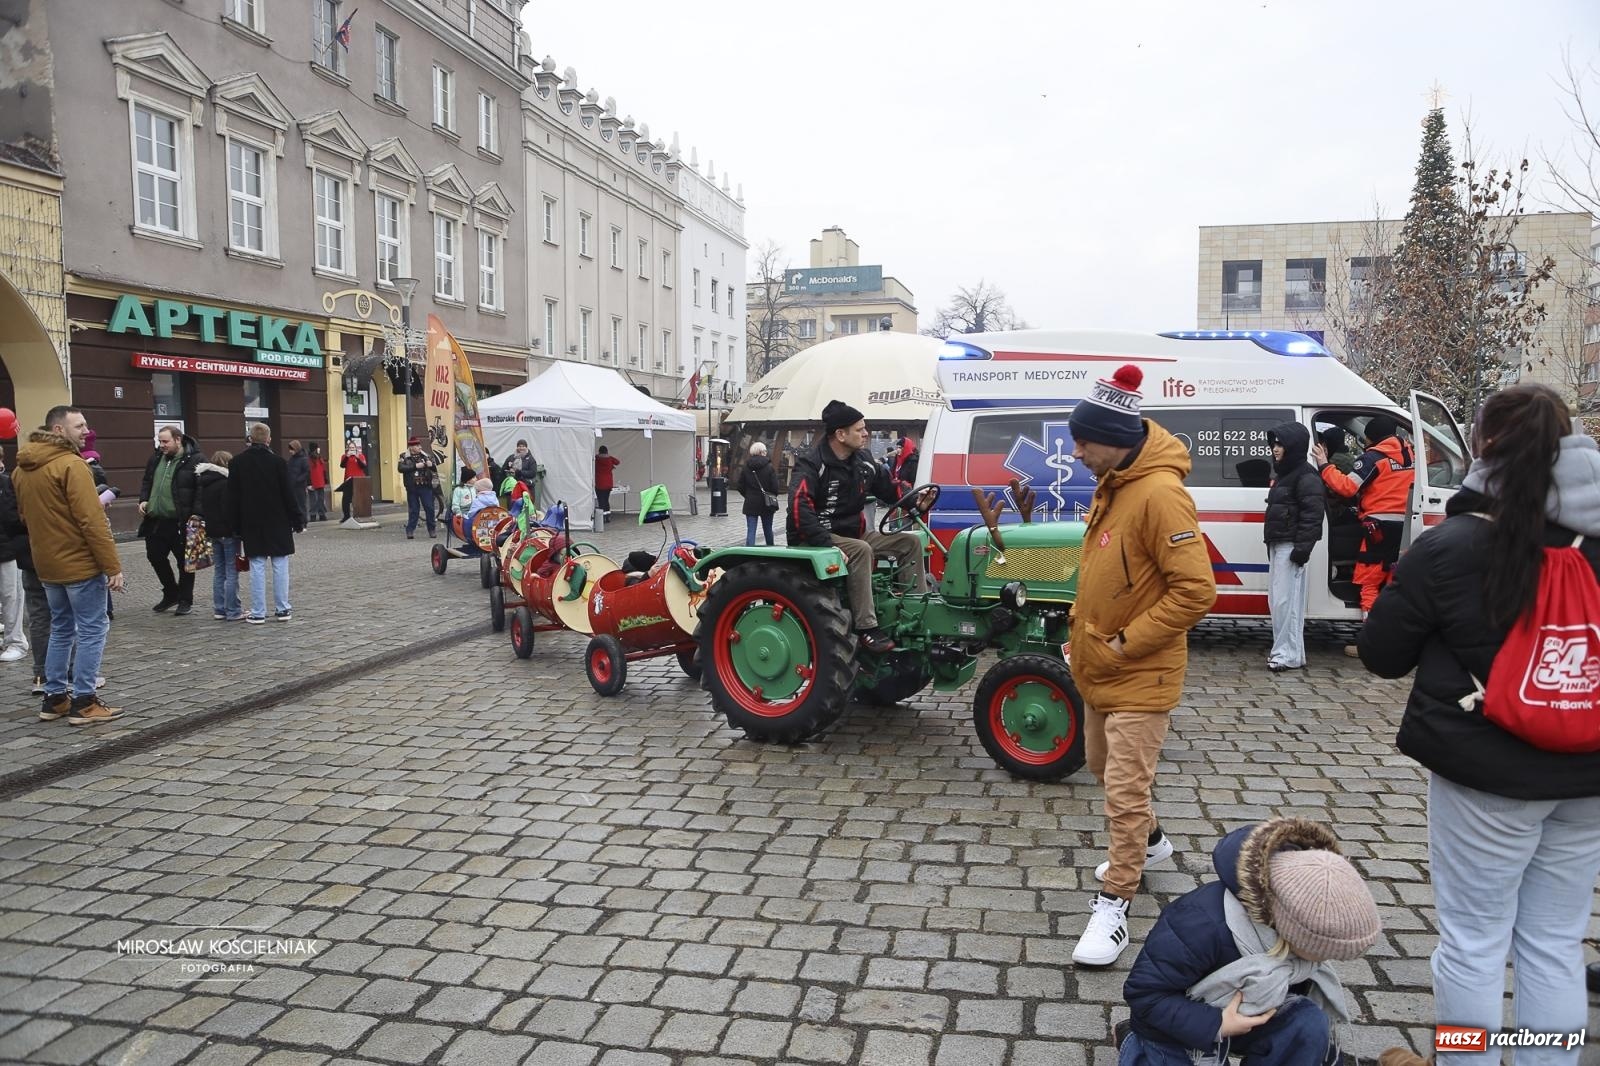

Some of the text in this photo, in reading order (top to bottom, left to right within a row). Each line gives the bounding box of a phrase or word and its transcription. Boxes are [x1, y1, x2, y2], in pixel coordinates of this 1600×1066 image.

[808, 275, 858, 285] McDonald's
[107, 294, 322, 354] APTEKA
[260, 352, 321, 367] POD RÓŻAMI
[140, 356, 175, 369] RYNEK
[177, 360, 188, 370] 12
[195, 361, 238, 374] CENTRUM
[238, 365, 308, 379] FARMACEUTYCZNE
[952, 370, 1088, 381] TRANSPORT MEDYCZNY
[1163, 376, 1196, 397] life
[1249, 378, 1285, 386] MEDYCZNE
[487, 415, 515, 423] Raciborskie
[542, 415, 560, 424] Kultury
[1198, 430, 1220, 441] 602
[1223, 430, 1246, 441] 622
[1198, 446, 1273, 456] 505 751 858
[1550, 701, 1593, 710] mBank
